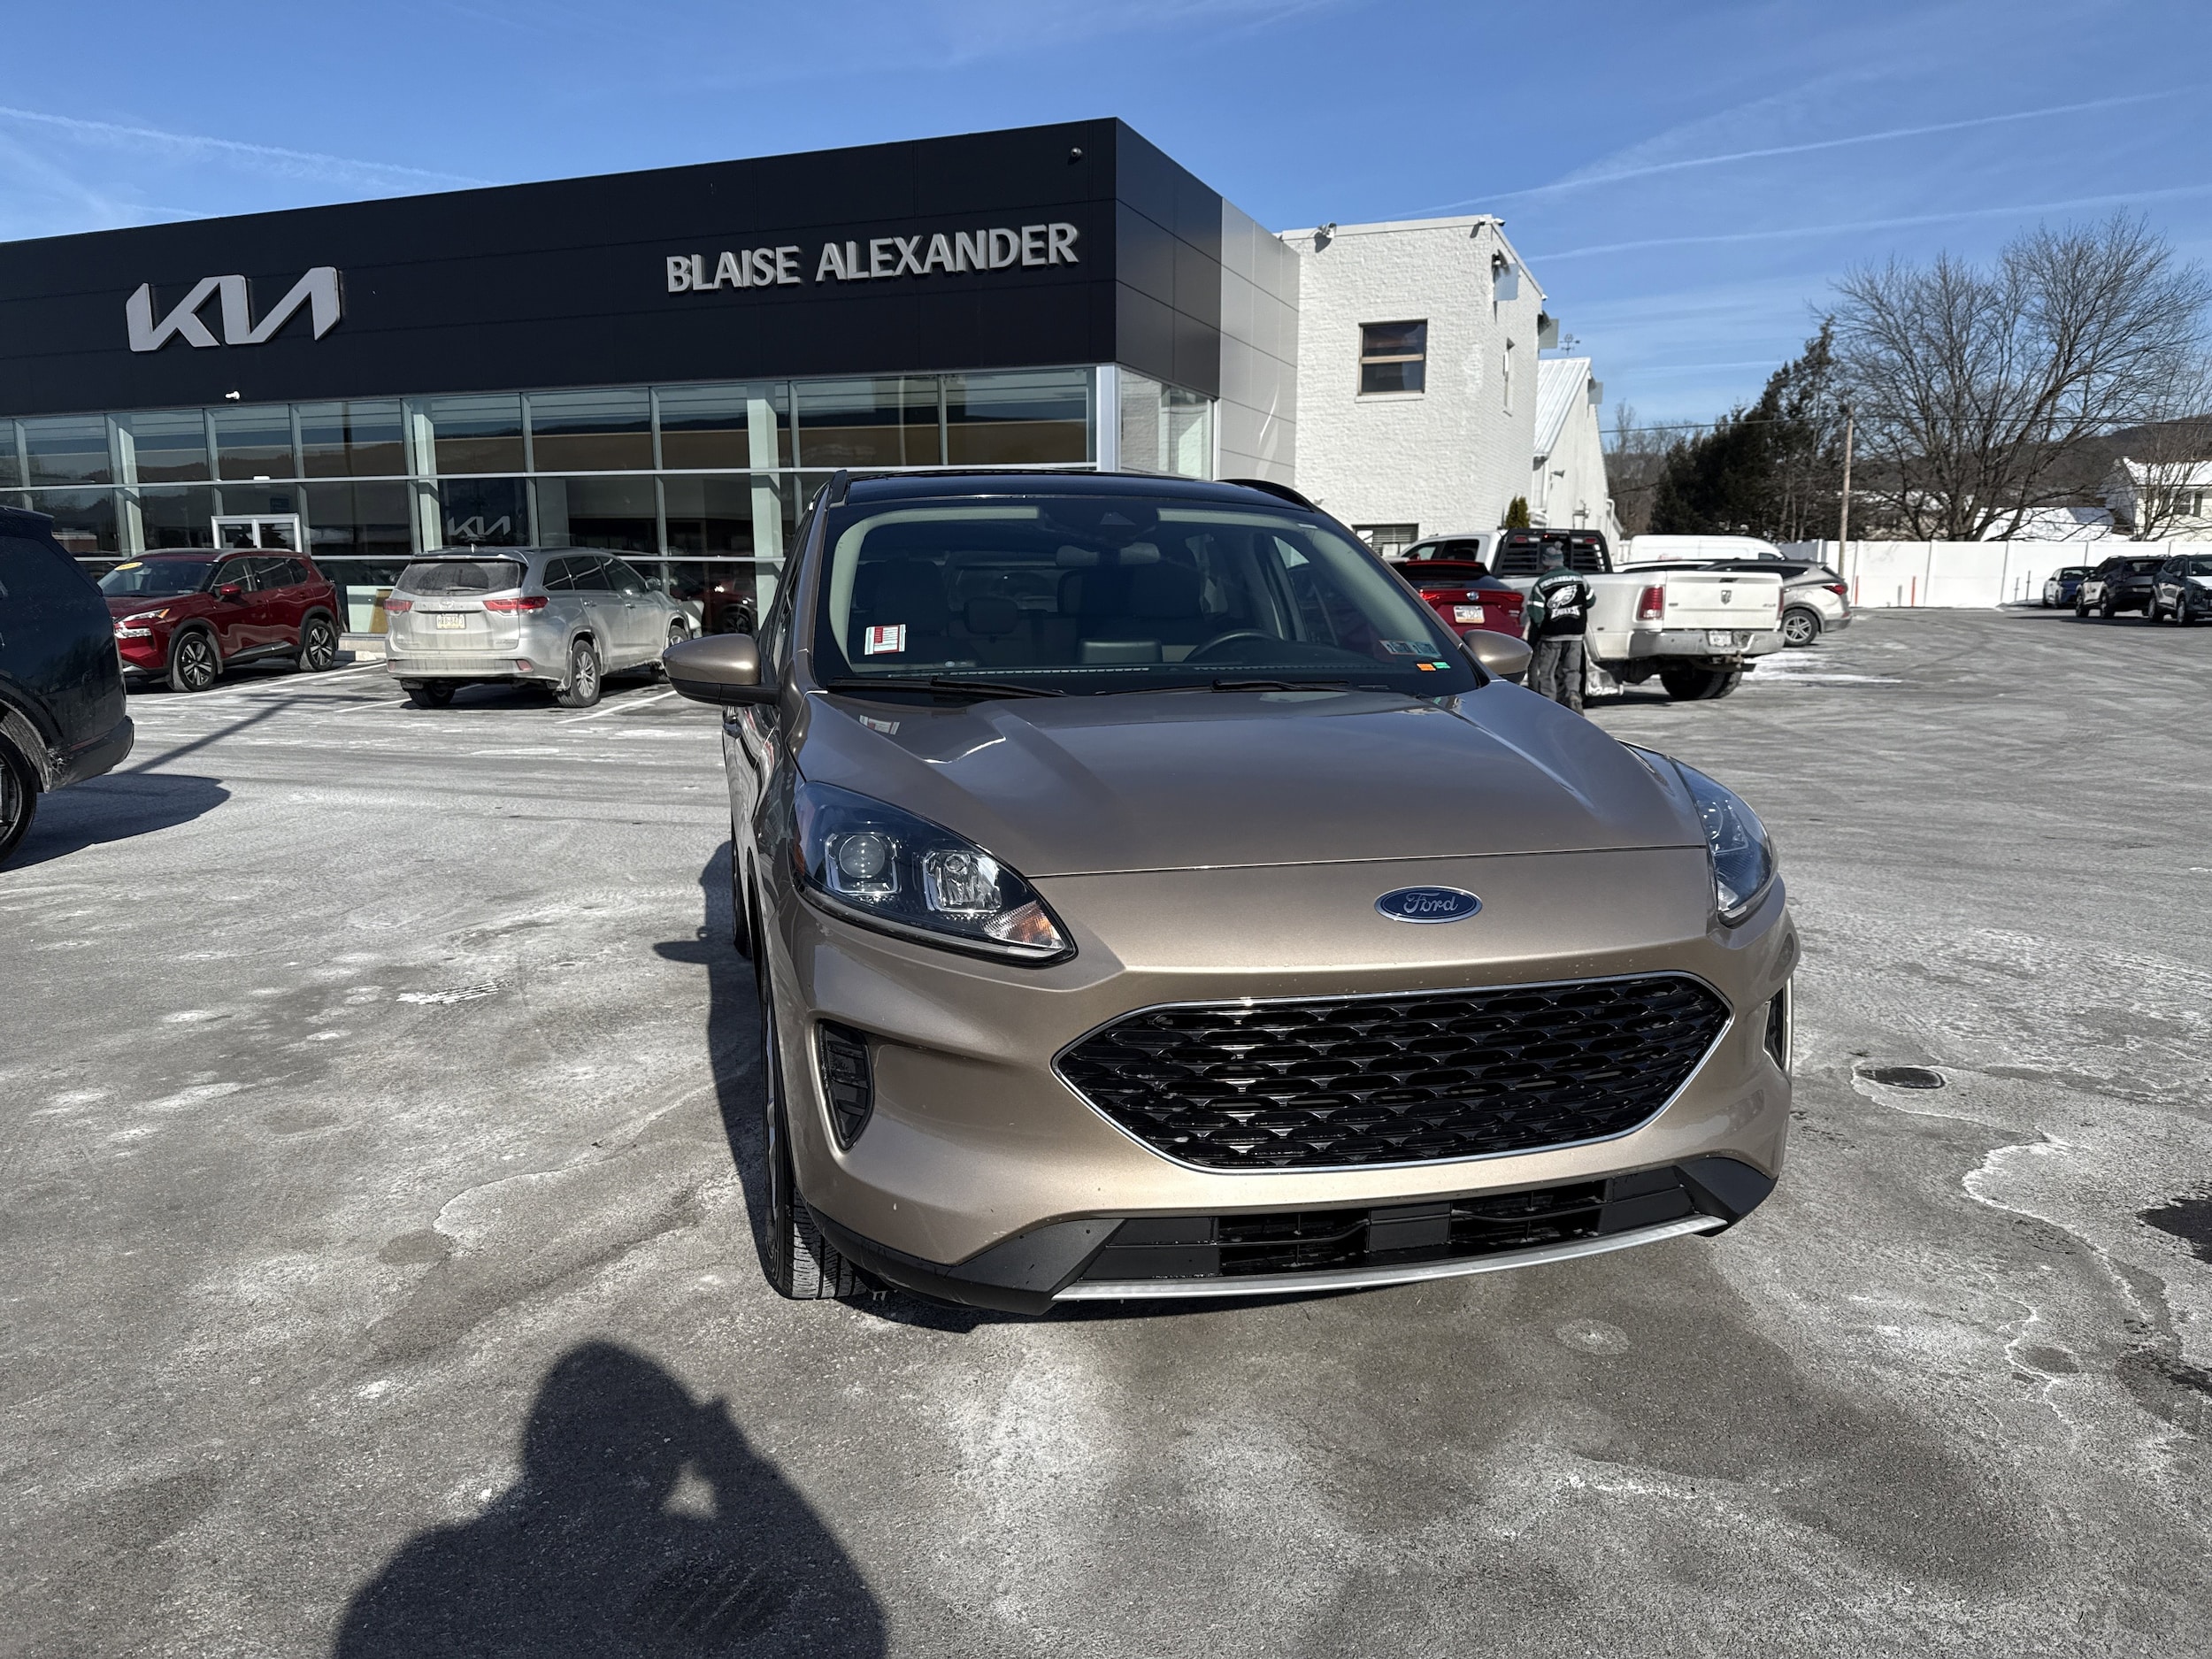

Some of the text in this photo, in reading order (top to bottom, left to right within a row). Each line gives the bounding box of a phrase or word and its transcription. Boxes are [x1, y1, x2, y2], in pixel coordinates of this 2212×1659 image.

[666, 221, 1081, 294] BLAISE ALEXANDER
[126, 265, 342, 353] KIA
[447, 516, 511, 538] KIA
[1403, 892, 1458, 913] Ford
